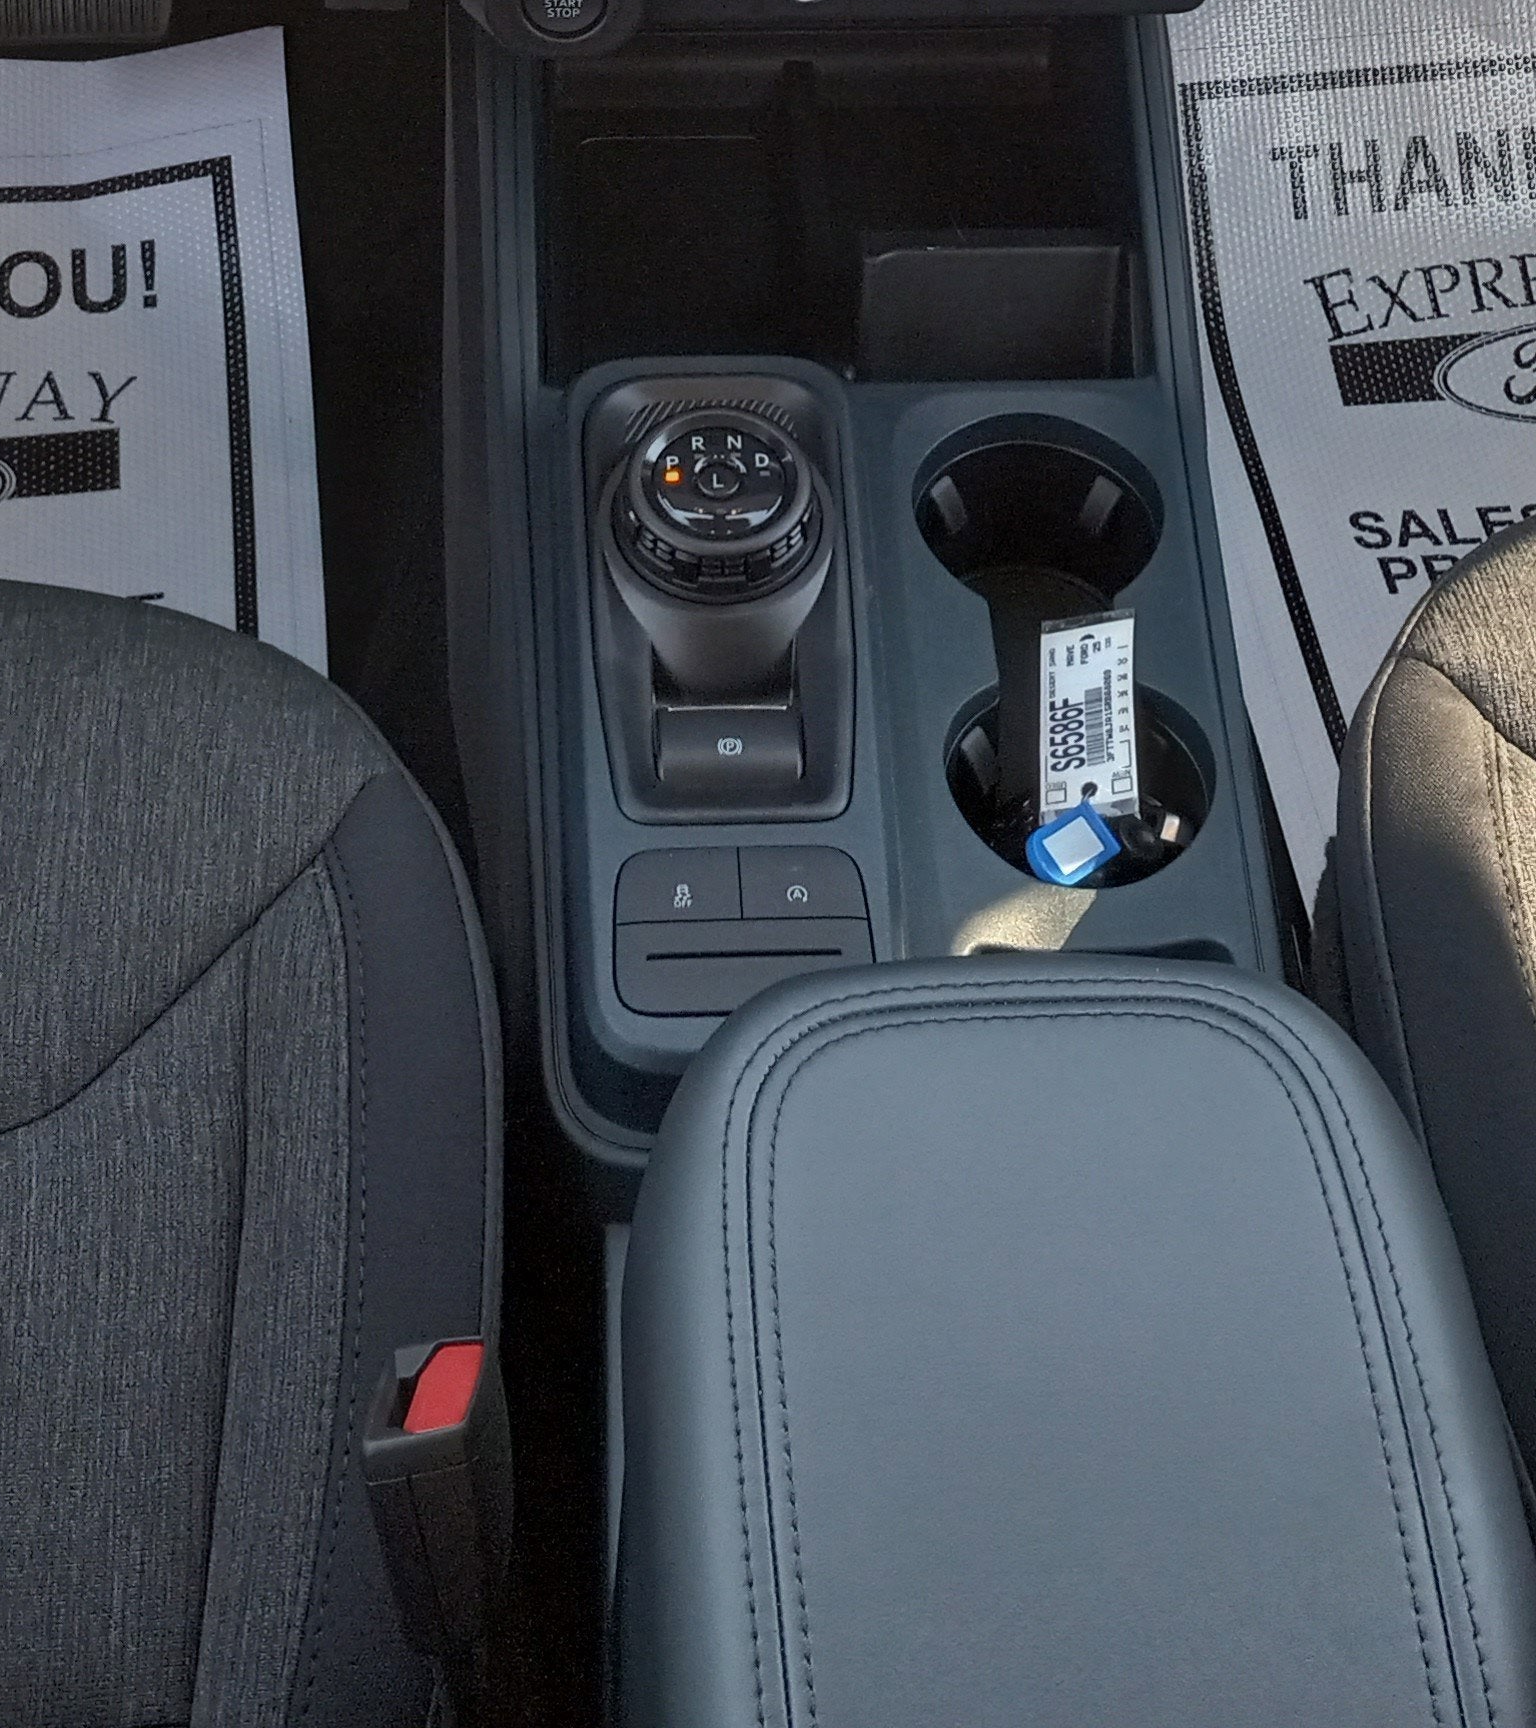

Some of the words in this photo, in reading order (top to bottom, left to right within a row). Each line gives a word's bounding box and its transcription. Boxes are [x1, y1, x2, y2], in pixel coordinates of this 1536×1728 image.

[547, 8, 580, 18] STOP
[691, 436, 706, 451] R
[727, 435, 742, 450] N
[755, 453, 769, 468] D
[712, 473, 724, 489] L
[1080, 643, 1089, 665] FORD
[1048, 698, 1086, 772] S6586F
[673, 897, 693, 909] OFF
